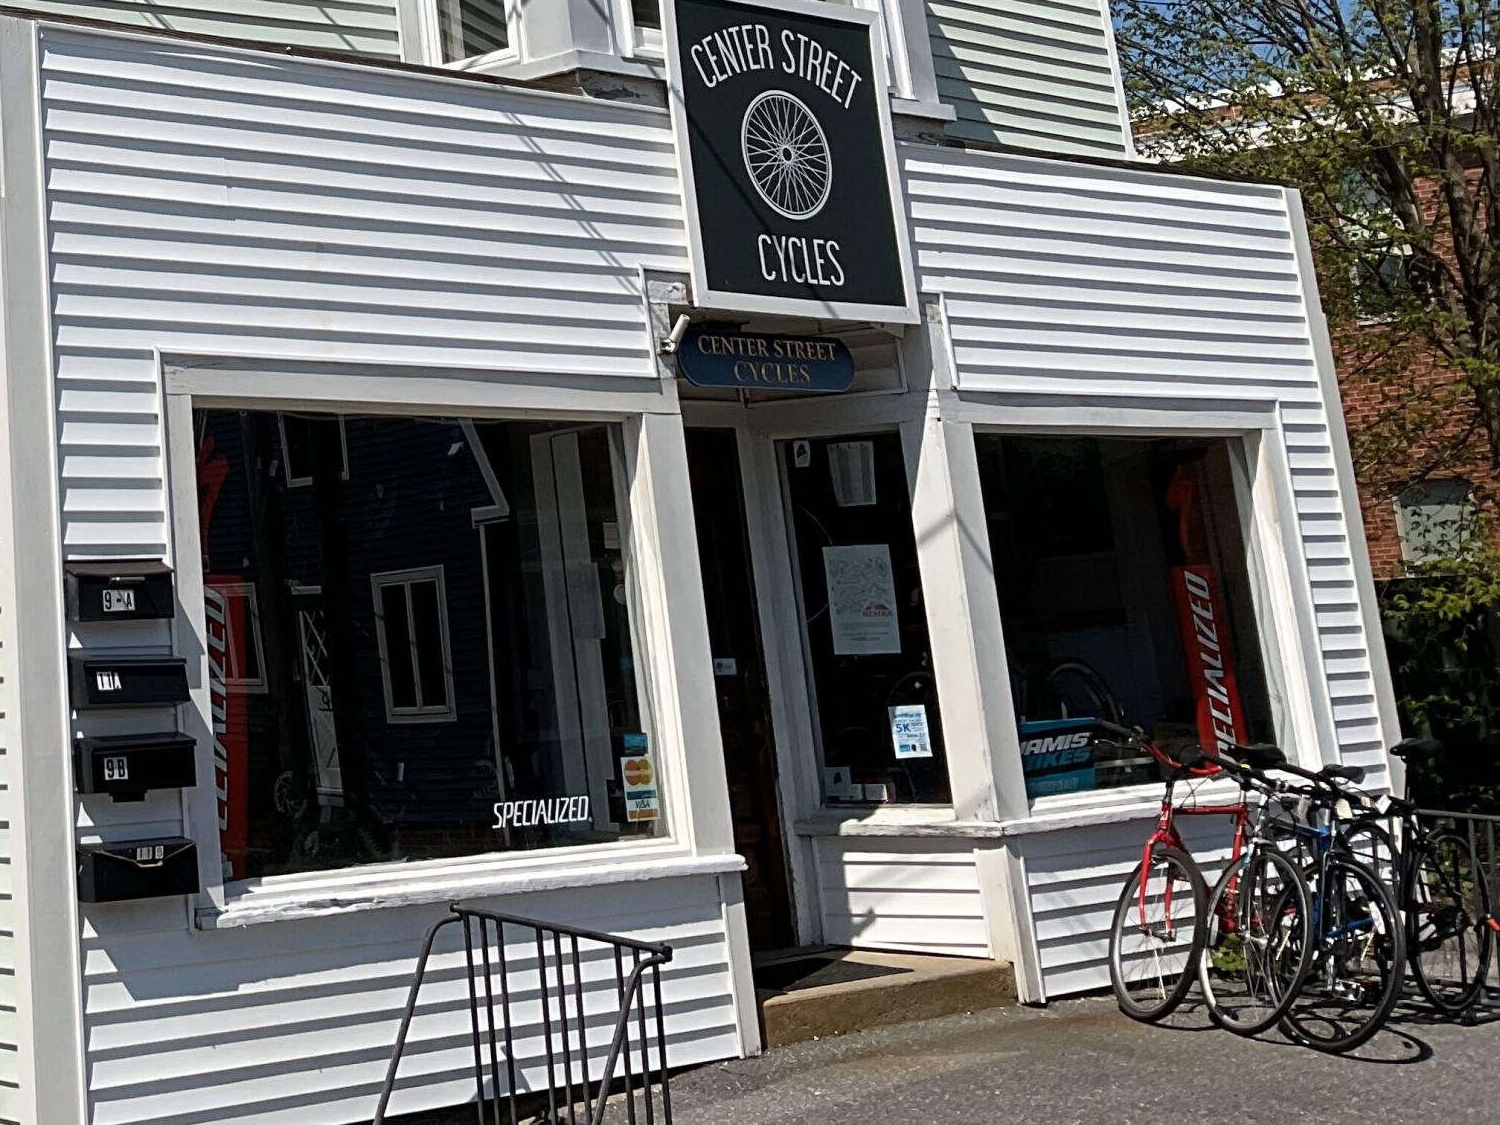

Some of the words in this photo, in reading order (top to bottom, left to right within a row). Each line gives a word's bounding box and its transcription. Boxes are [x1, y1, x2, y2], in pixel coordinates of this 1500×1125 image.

[690, 24, 774, 88] CENTER
[781, 30, 862, 109] STREET
[757, 234, 845, 287] CYCLES
[698, 335, 769, 357] CENTER
[773, 339, 836, 361] STREET
[733, 360, 811, 384] CYCLES
[1184, 570, 1237, 764] PECIALIZED
[896, 723, 911, 733] 5K
[106, 758, 126, 779] 9B
[491, 795, 589, 829] SPECIALIZED
[635, 799, 650, 809] VISA
